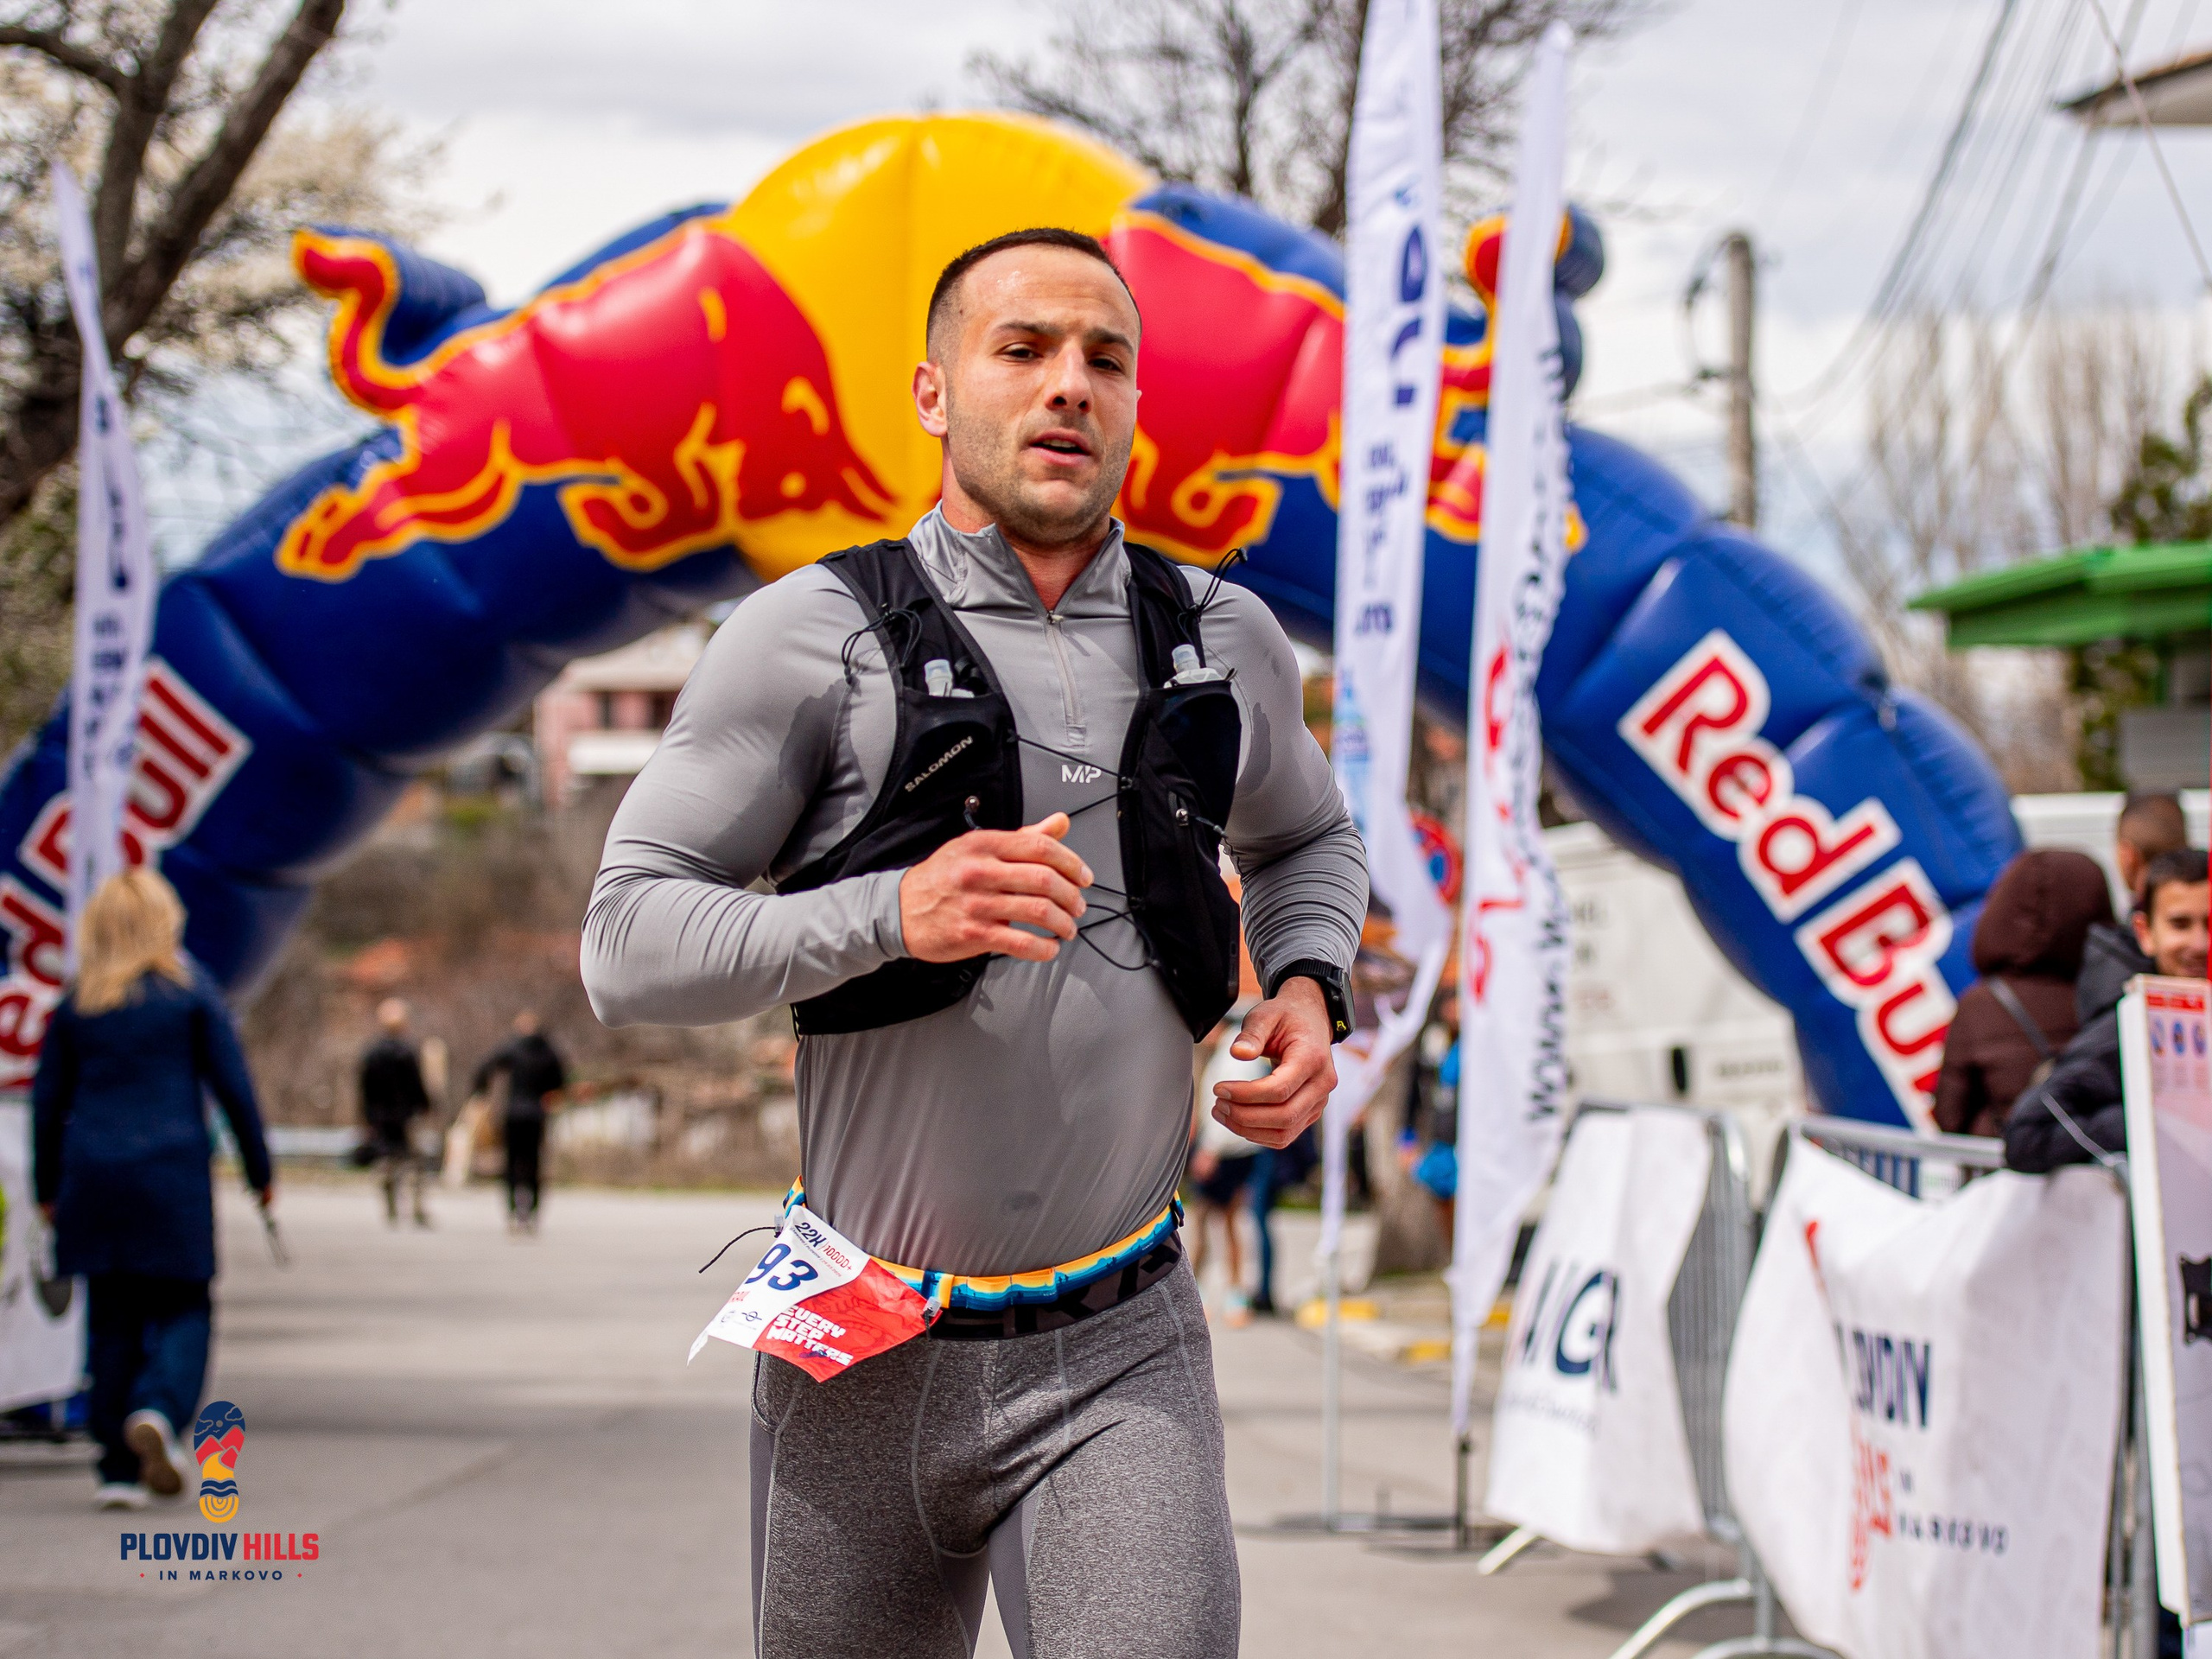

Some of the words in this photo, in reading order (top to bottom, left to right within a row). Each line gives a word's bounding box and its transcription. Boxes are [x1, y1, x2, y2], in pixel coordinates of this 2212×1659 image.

[904, 735, 974, 792] SALOMON
[1640, 654, 1877, 898] Red
[1819, 882, 1953, 1122] Bu
[773, 1313, 825, 1340] STEP
[781, 1305, 847, 1338] EVERY
[766, 1325, 855, 1366] MATTERS
